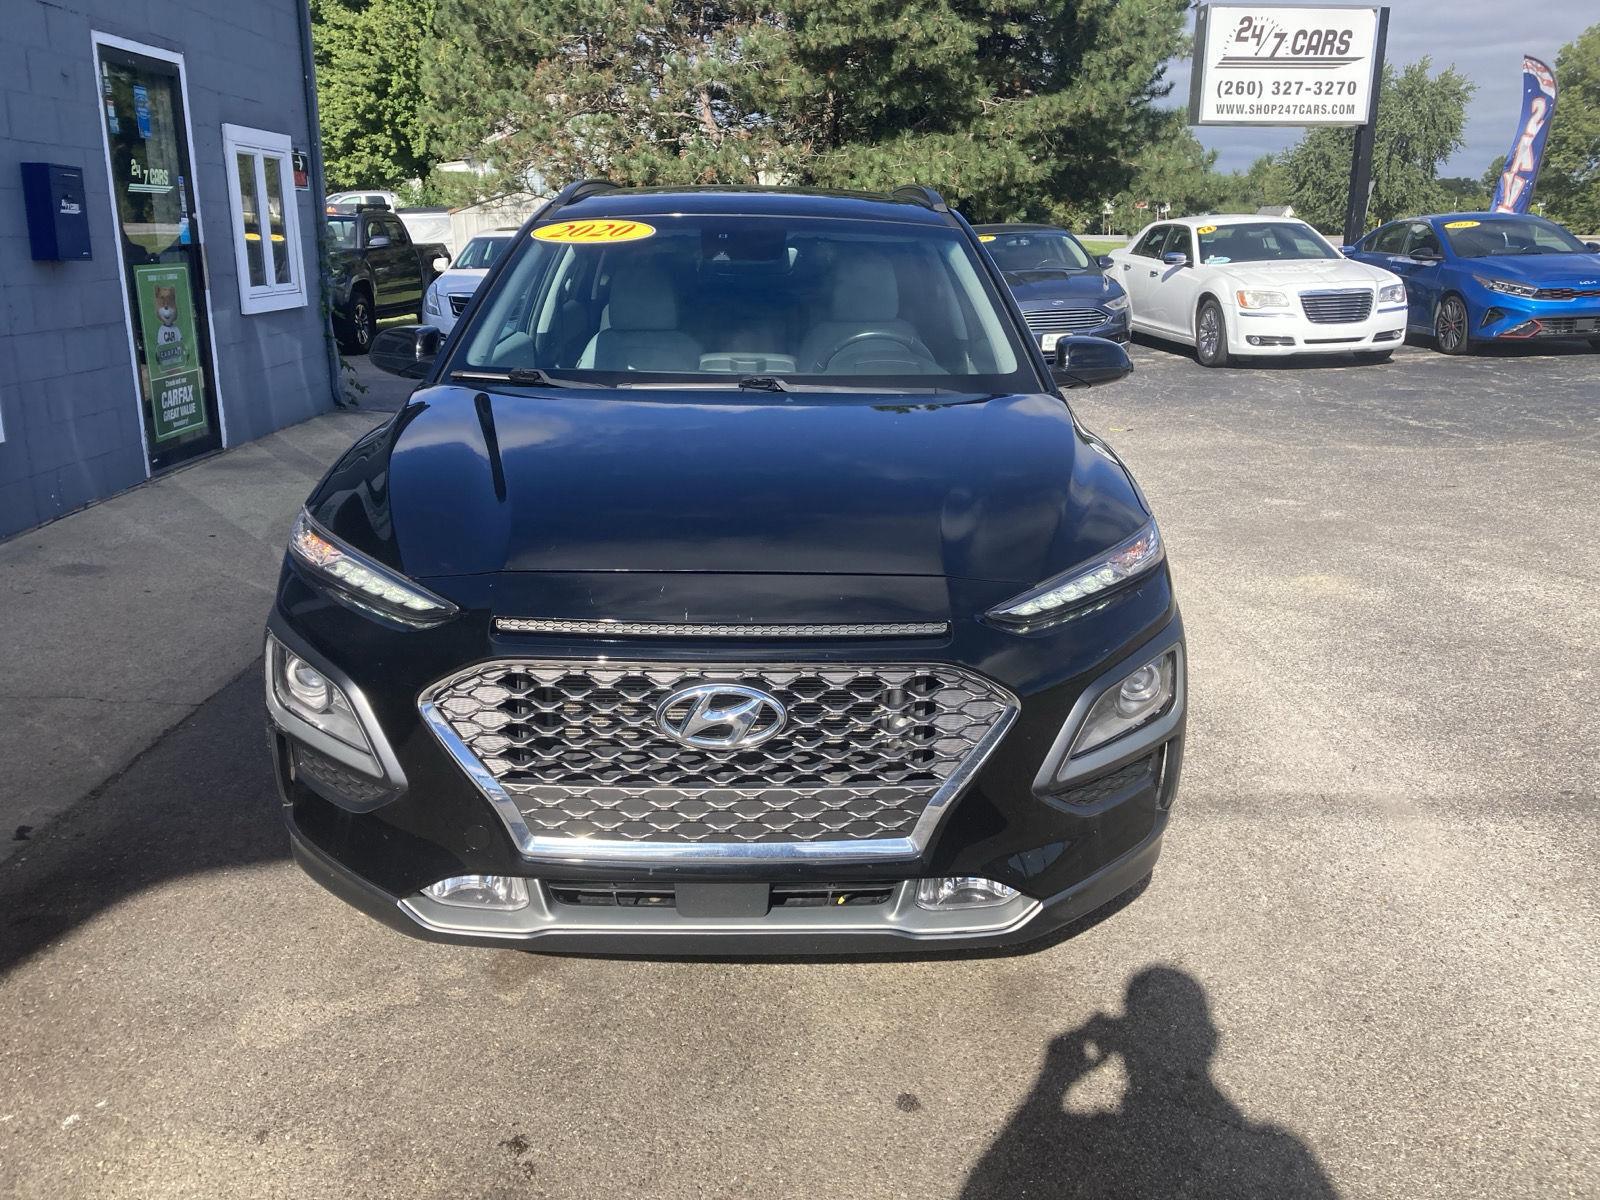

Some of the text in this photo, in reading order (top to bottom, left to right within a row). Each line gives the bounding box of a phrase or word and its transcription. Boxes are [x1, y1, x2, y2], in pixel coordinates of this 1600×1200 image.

[1291, 29, 1353, 56] CARS
[1217, 80, 1357, 98] (260) 327-3270
[1216, 103, 1355, 115] WWW.SHOP247CARS.COM
[547, 224, 637, 238] 2020
[163, 331, 175, 342] CAR
[161, 385, 194, 409] CARFAX
[163, 402, 196, 422] GREAT VALUE
